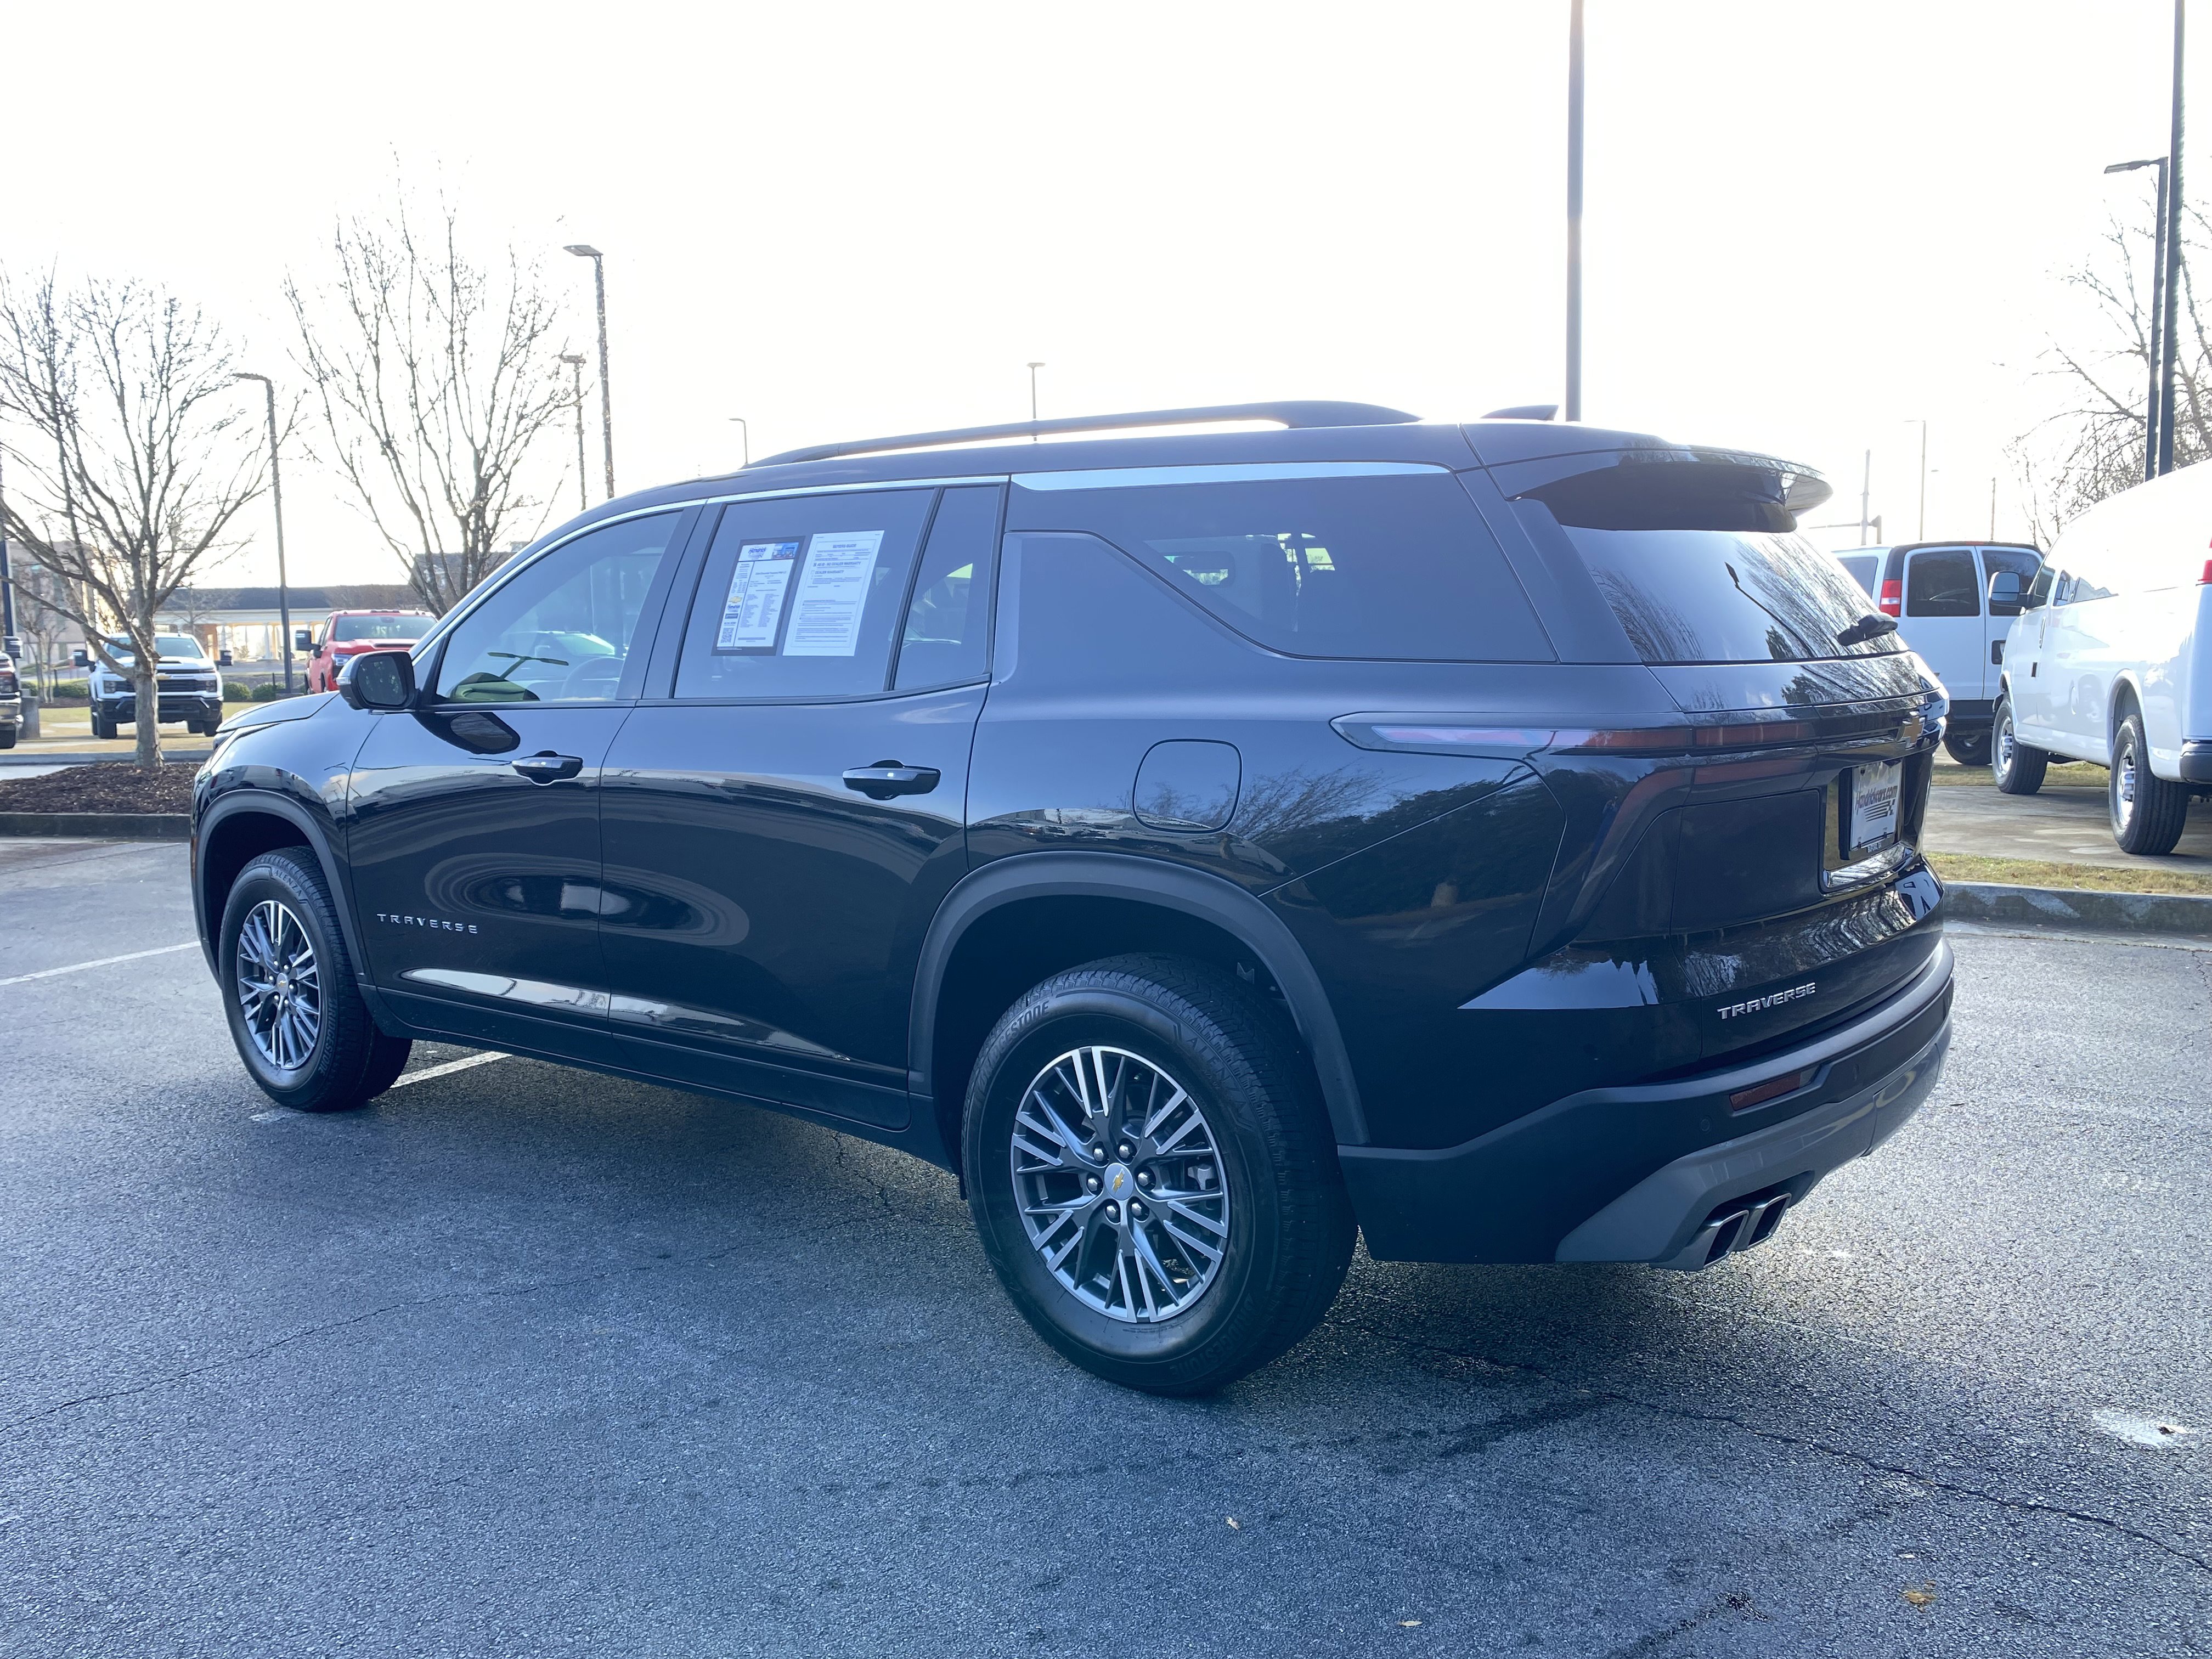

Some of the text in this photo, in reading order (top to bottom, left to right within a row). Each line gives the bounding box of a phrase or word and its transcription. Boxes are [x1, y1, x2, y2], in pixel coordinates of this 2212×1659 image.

[274, 870, 302, 896] ALENZA
[376, 913, 478, 934] TRAVERSE
[1716, 982, 1816, 1020] TRAVERSE
[1187, 1037, 1248, 1114] ALENZA
